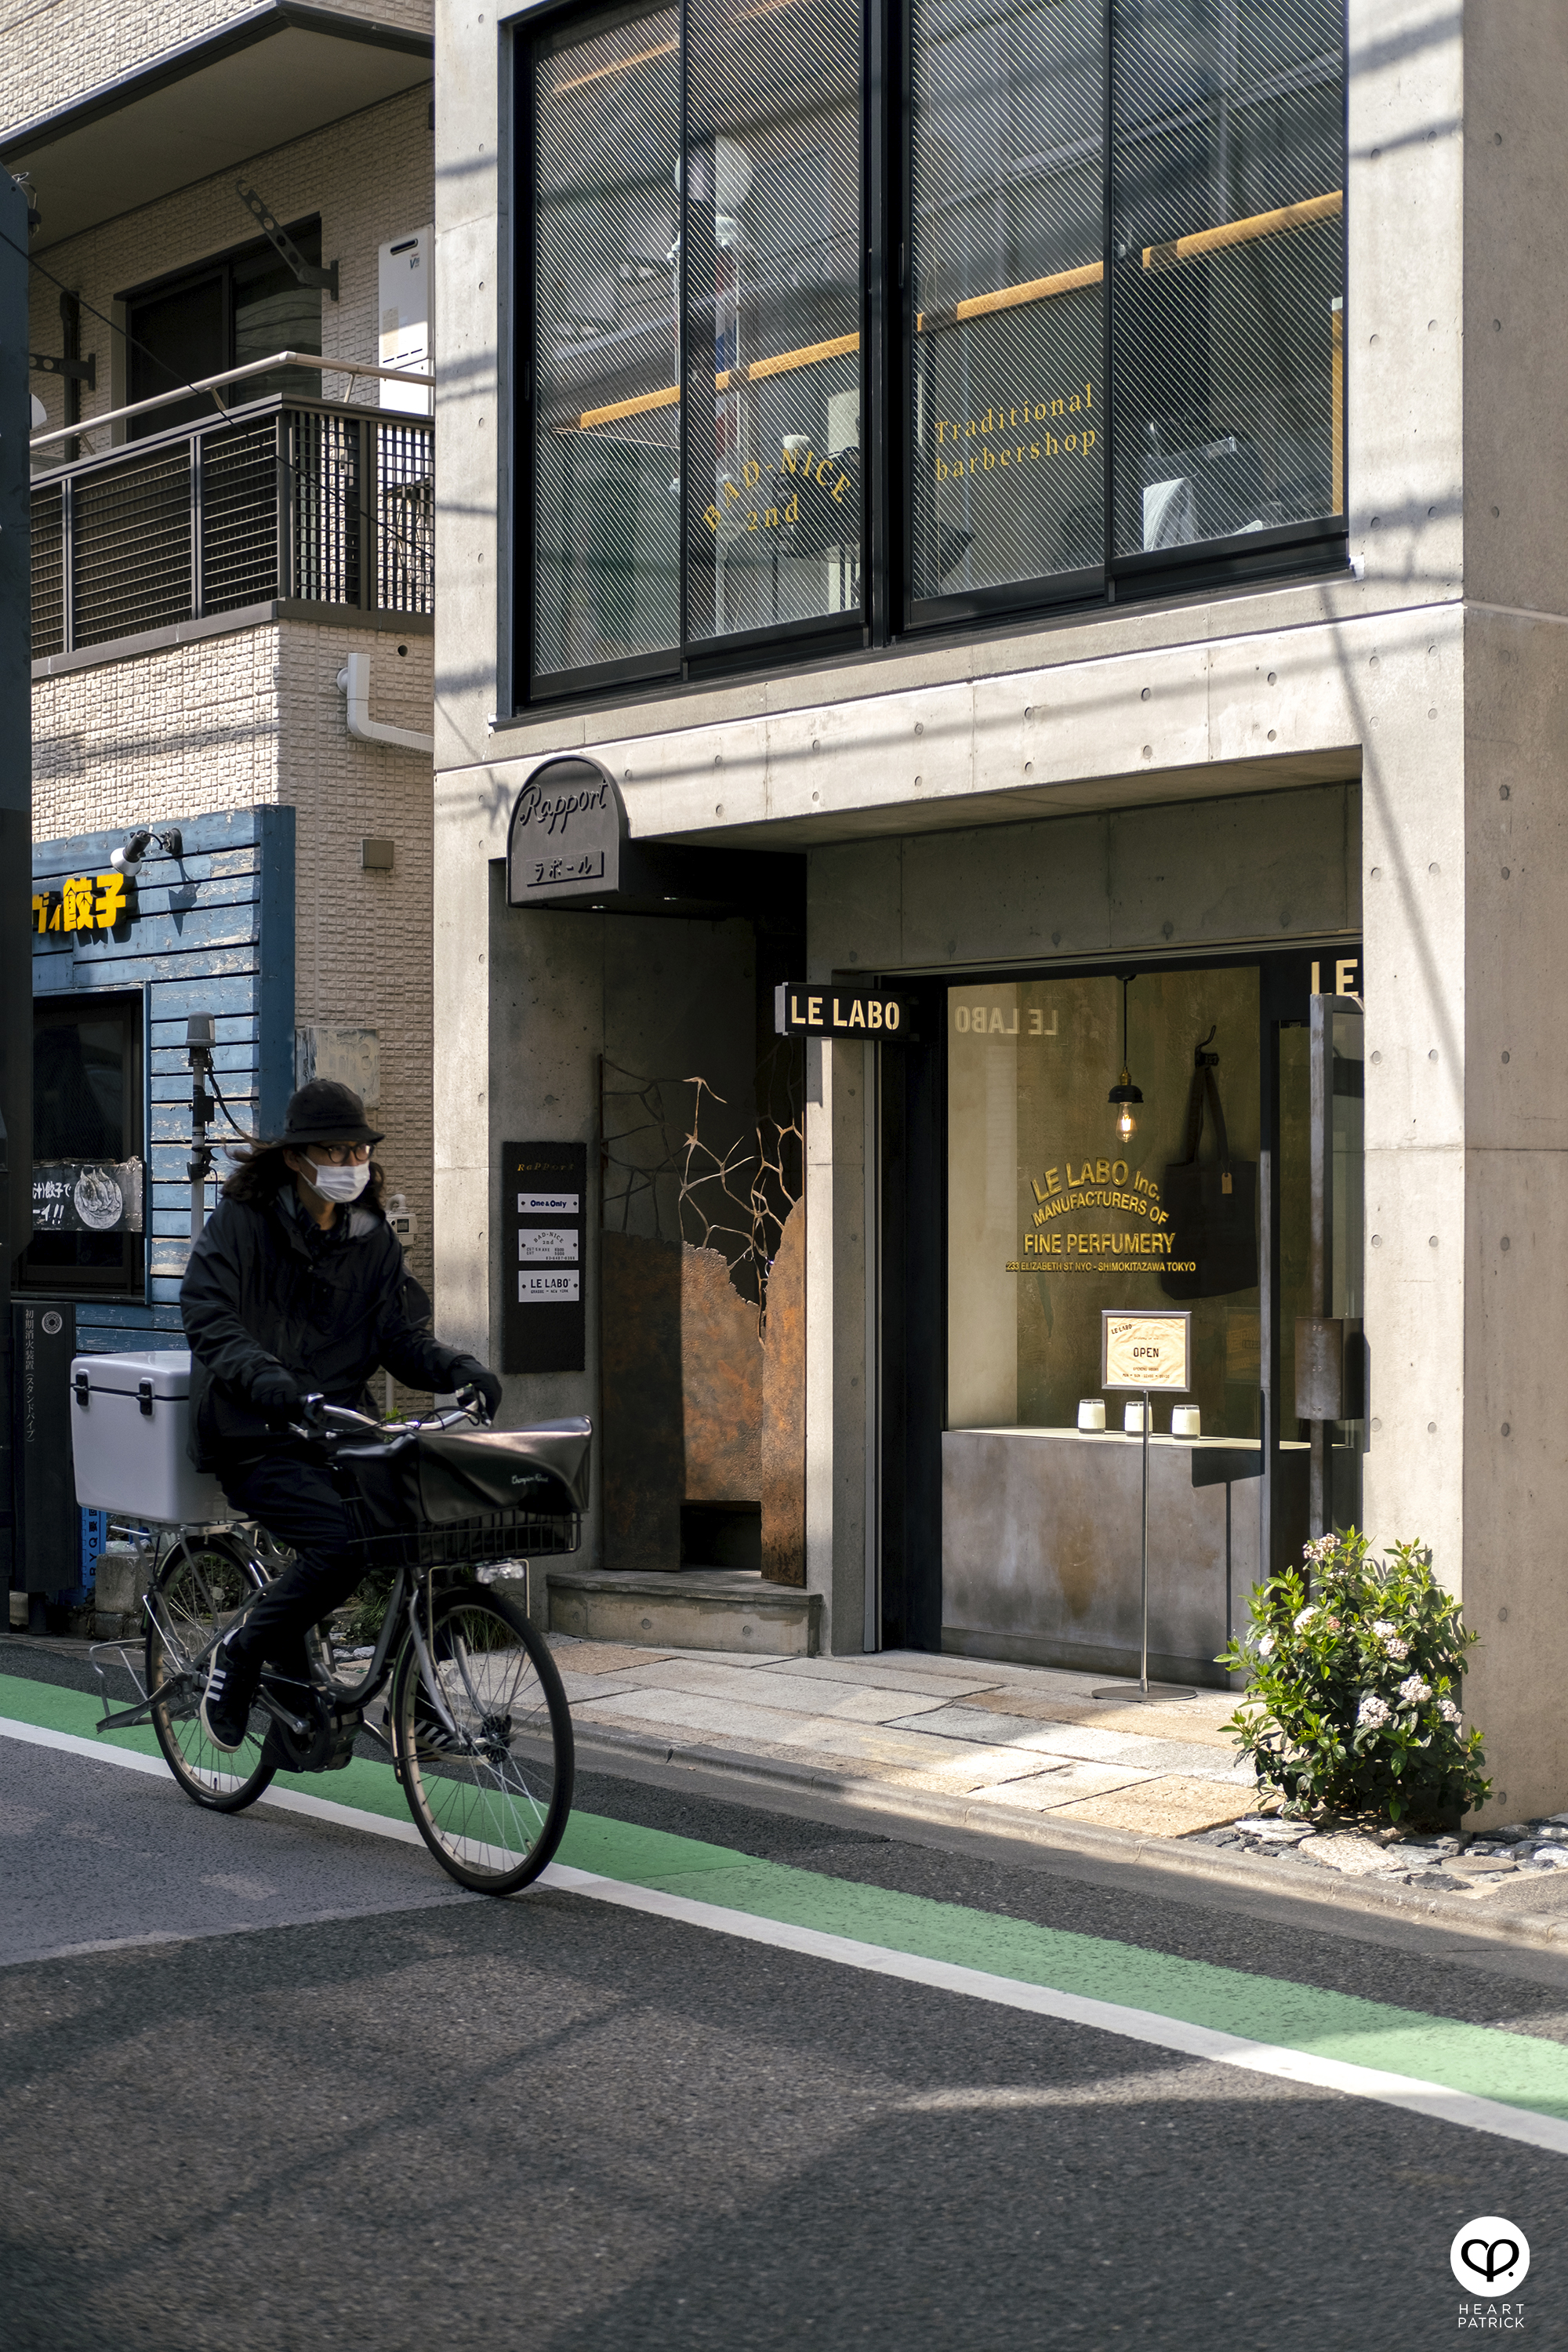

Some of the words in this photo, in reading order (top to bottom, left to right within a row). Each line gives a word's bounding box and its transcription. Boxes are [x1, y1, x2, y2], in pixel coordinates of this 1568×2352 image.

[935, 383, 1092, 443] Traditional
[935, 430, 1095, 481] barbershop
[702, 448, 851, 532] BAD-NICE
[747, 494, 799, 531] 2nd
[519, 779, 608, 835] Rapport
[1311, 959, 1359, 997] LE
[791, 995, 823, 1025] LE
[833, 998, 900, 1030] LABO
[1031, 1166, 1062, 1205] LE
[1065, 1156, 1129, 1189] LABO
[1133, 1171, 1161, 1203] Inc.
[1032, 1190, 1148, 1228] MANUFACTURERS
[1149, 1206, 1170, 1226] OF
[533, 1232, 564, 1243] BAD-NICE
[1024, 1233, 1062, 1254] FINE
[1066, 1232, 1176, 1254] PERFUMERY
[531, 1279, 542, 1288] LE
[1006, 1261, 1019, 1272] 233
[1021, 1261, 1062, 1272] ELIZABETH
[1063, 1261, 1073, 1271] ST
[1075, 1261, 1092, 1272] NYC
[1098, 1261, 1166, 1272] SHIMOKITAZAWA
[1167, 1261, 1196, 1272] TOKYO
[1119, 1323, 1132, 1332] LABO
[1133, 1347, 1159, 1358] OPEN
